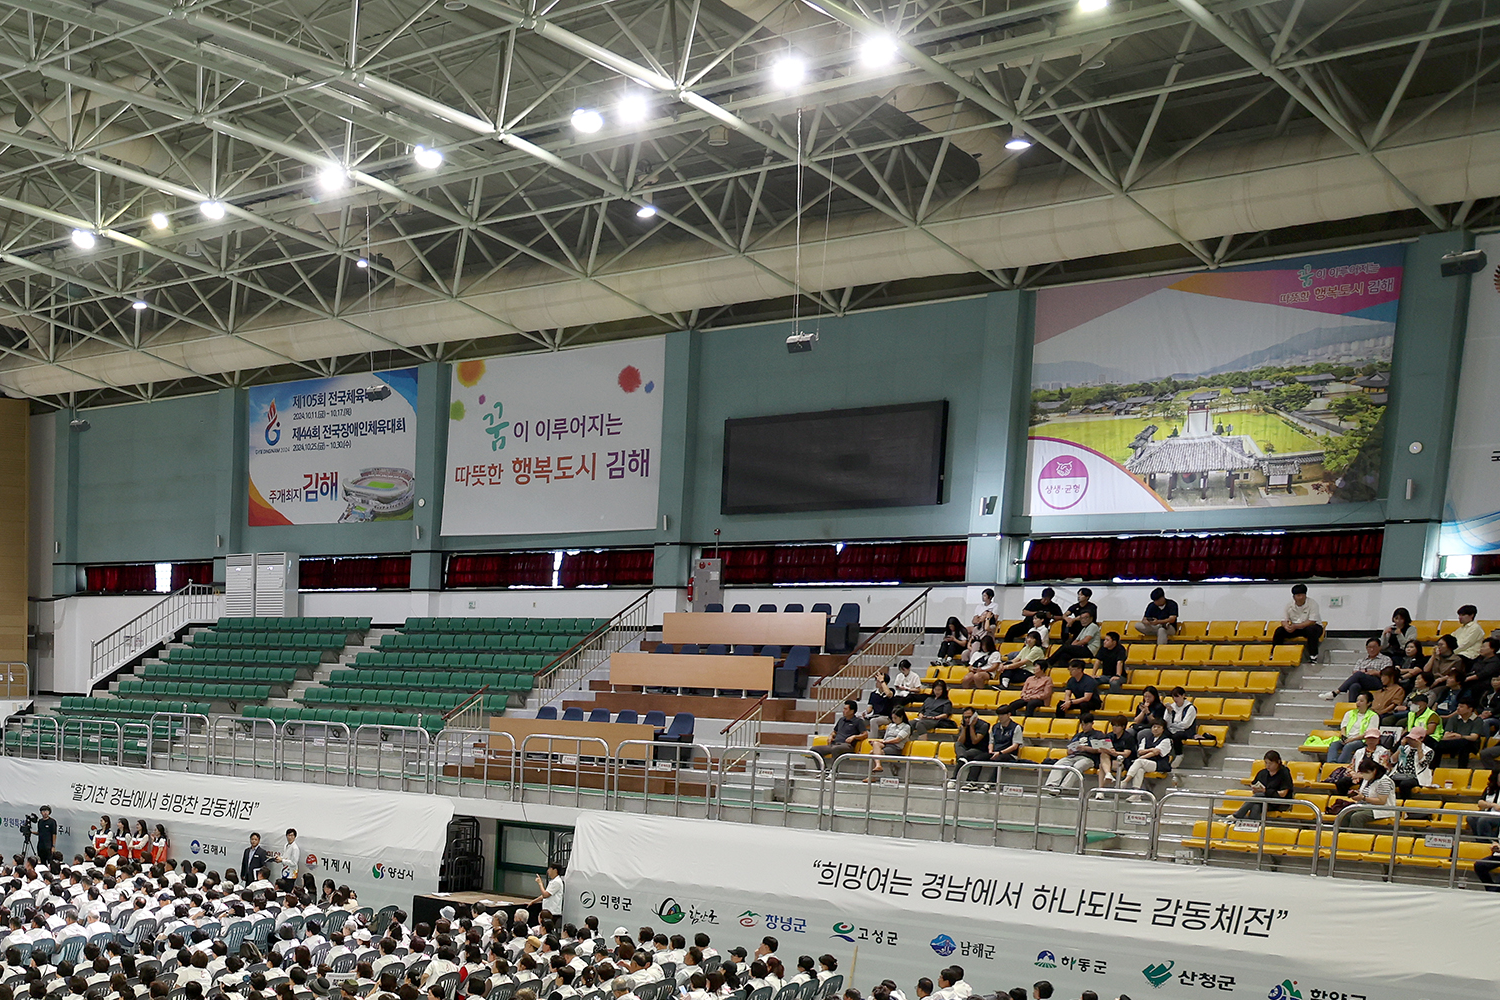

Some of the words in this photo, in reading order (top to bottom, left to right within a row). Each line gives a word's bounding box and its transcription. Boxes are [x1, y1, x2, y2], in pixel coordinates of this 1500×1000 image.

[1313, 281, 1365, 301] 행복도시
[1368, 277, 1395, 294] 김해
[292, 392, 326, 408] 제105회
[292, 424, 321, 441] 제44회
[322, 417, 406, 440] 전국장애인체육대회
[535, 413, 623, 442] 이루어지는
[455, 462, 504, 487] 따뜻한
[511, 452, 597, 485] 행복도시
[606, 448, 651, 480] 김해
[269, 487, 302, 504] 주개최지
[303, 472, 338, 503] 김해
[110, 787, 158, 809] 경남에서
[159, 792, 198, 815] 희망찬
[202, 843, 227, 857] 김해시
[320, 857, 351, 874] 거제시
[388, 867, 414, 881] 양산시
[599, 894, 632, 912] 의령군
[920, 872, 1023, 910] 경남에서
[1030, 884, 1142, 923] 하나되는
[1150, 897, 1288, 938] 감동체전”
[765, 914, 807, 933] 창녕군
[857, 926, 898, 946] 고성군
[960, 940, 996, 960] 남해군
[1061, 956, 1107, 974] 하동군
[1177, 970, 1236, 991] 산청군
